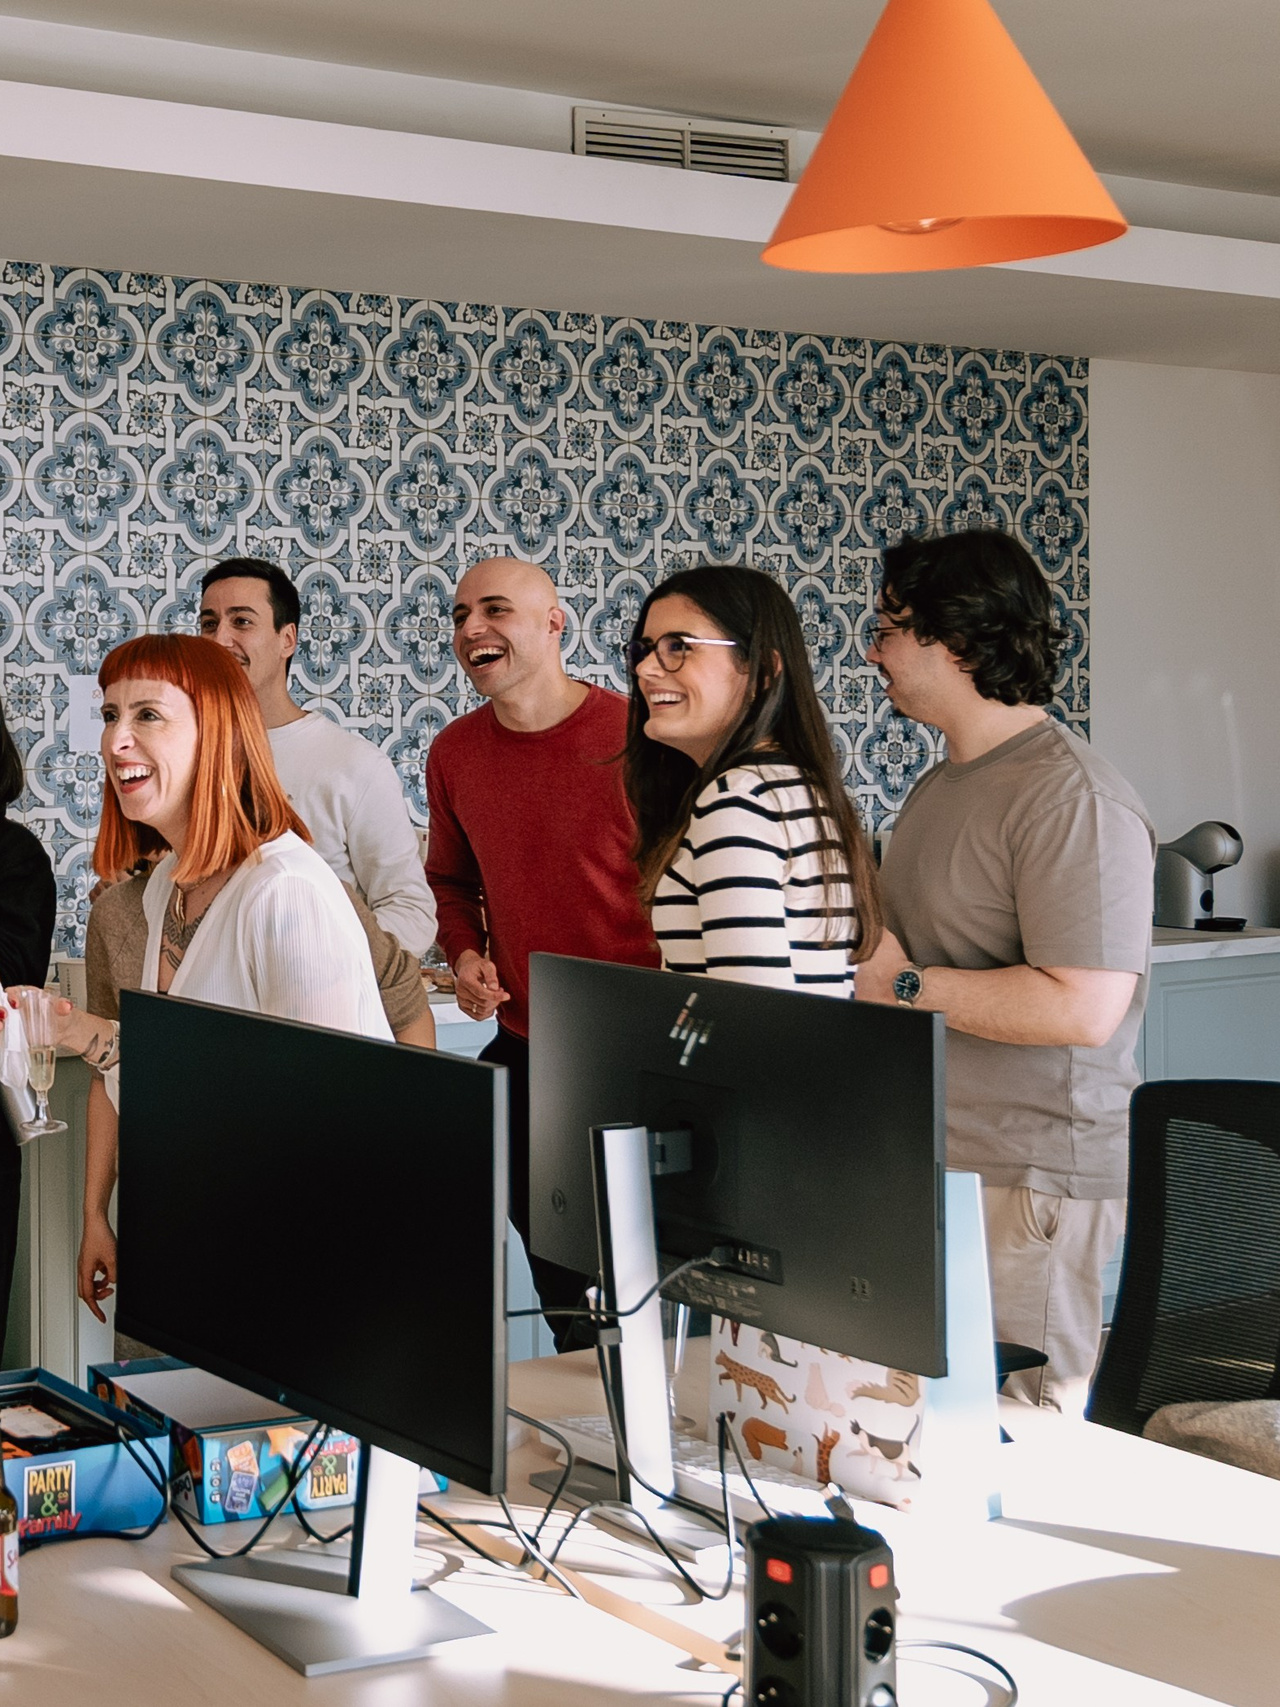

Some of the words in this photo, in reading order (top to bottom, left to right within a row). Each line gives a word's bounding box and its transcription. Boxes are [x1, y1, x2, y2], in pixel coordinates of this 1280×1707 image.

[321, 1455, 337, 1476] &
[29, 1465, 71, 1496] PARTY
[311, 1473, 347, 1497] PARTY
[41, 1491, 59, 1517] &
